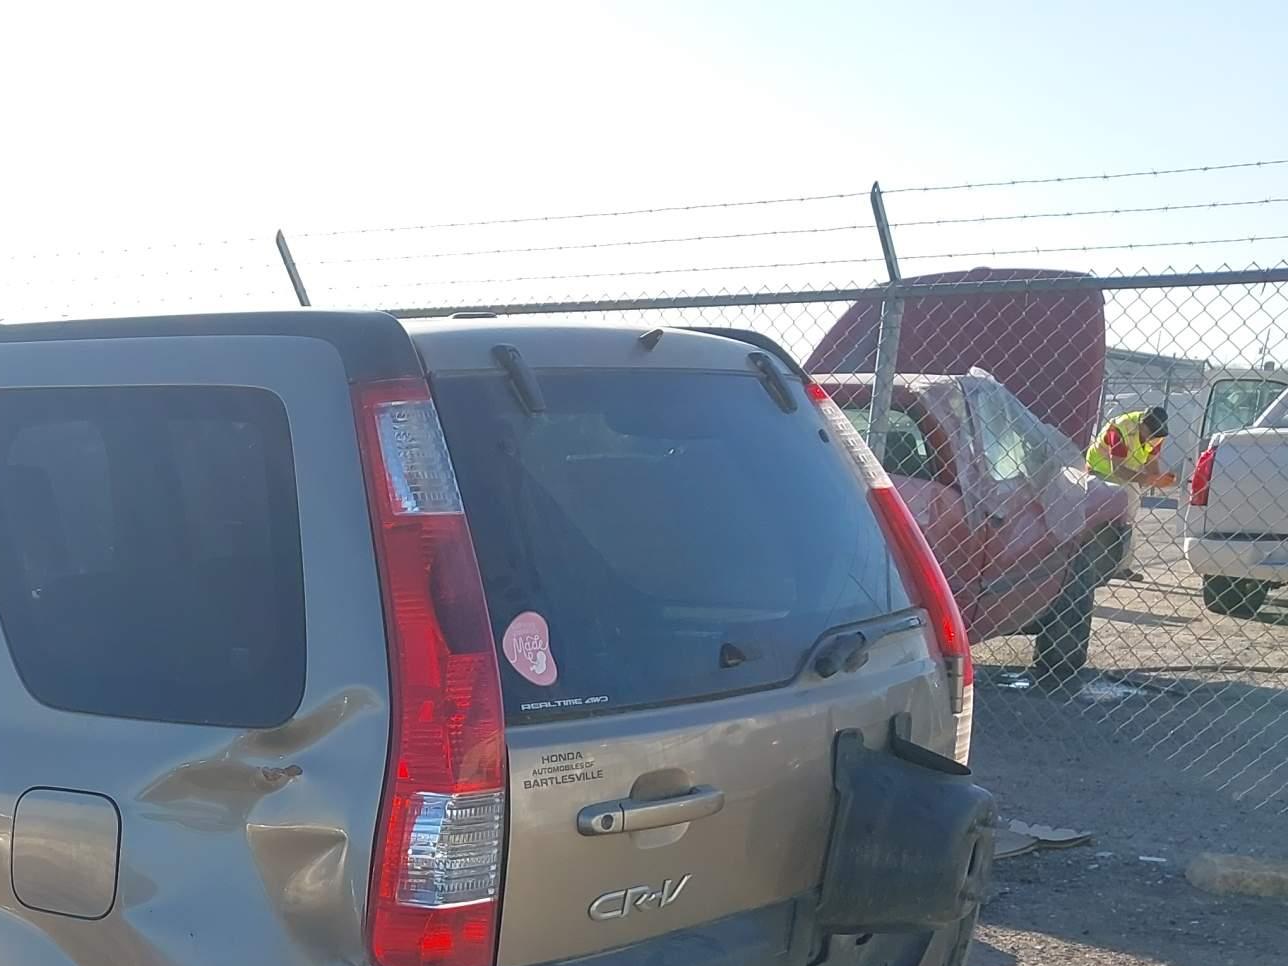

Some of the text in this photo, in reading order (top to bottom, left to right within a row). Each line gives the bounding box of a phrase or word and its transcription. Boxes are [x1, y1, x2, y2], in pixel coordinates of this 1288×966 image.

[541, 751, 584, 765] HONDA
[532, 760, 596, 776] AUTOMOBILES OF
[523, 769, 604, 790] BARTLESVILLE
[587, 872, 693, 921] CR-V
